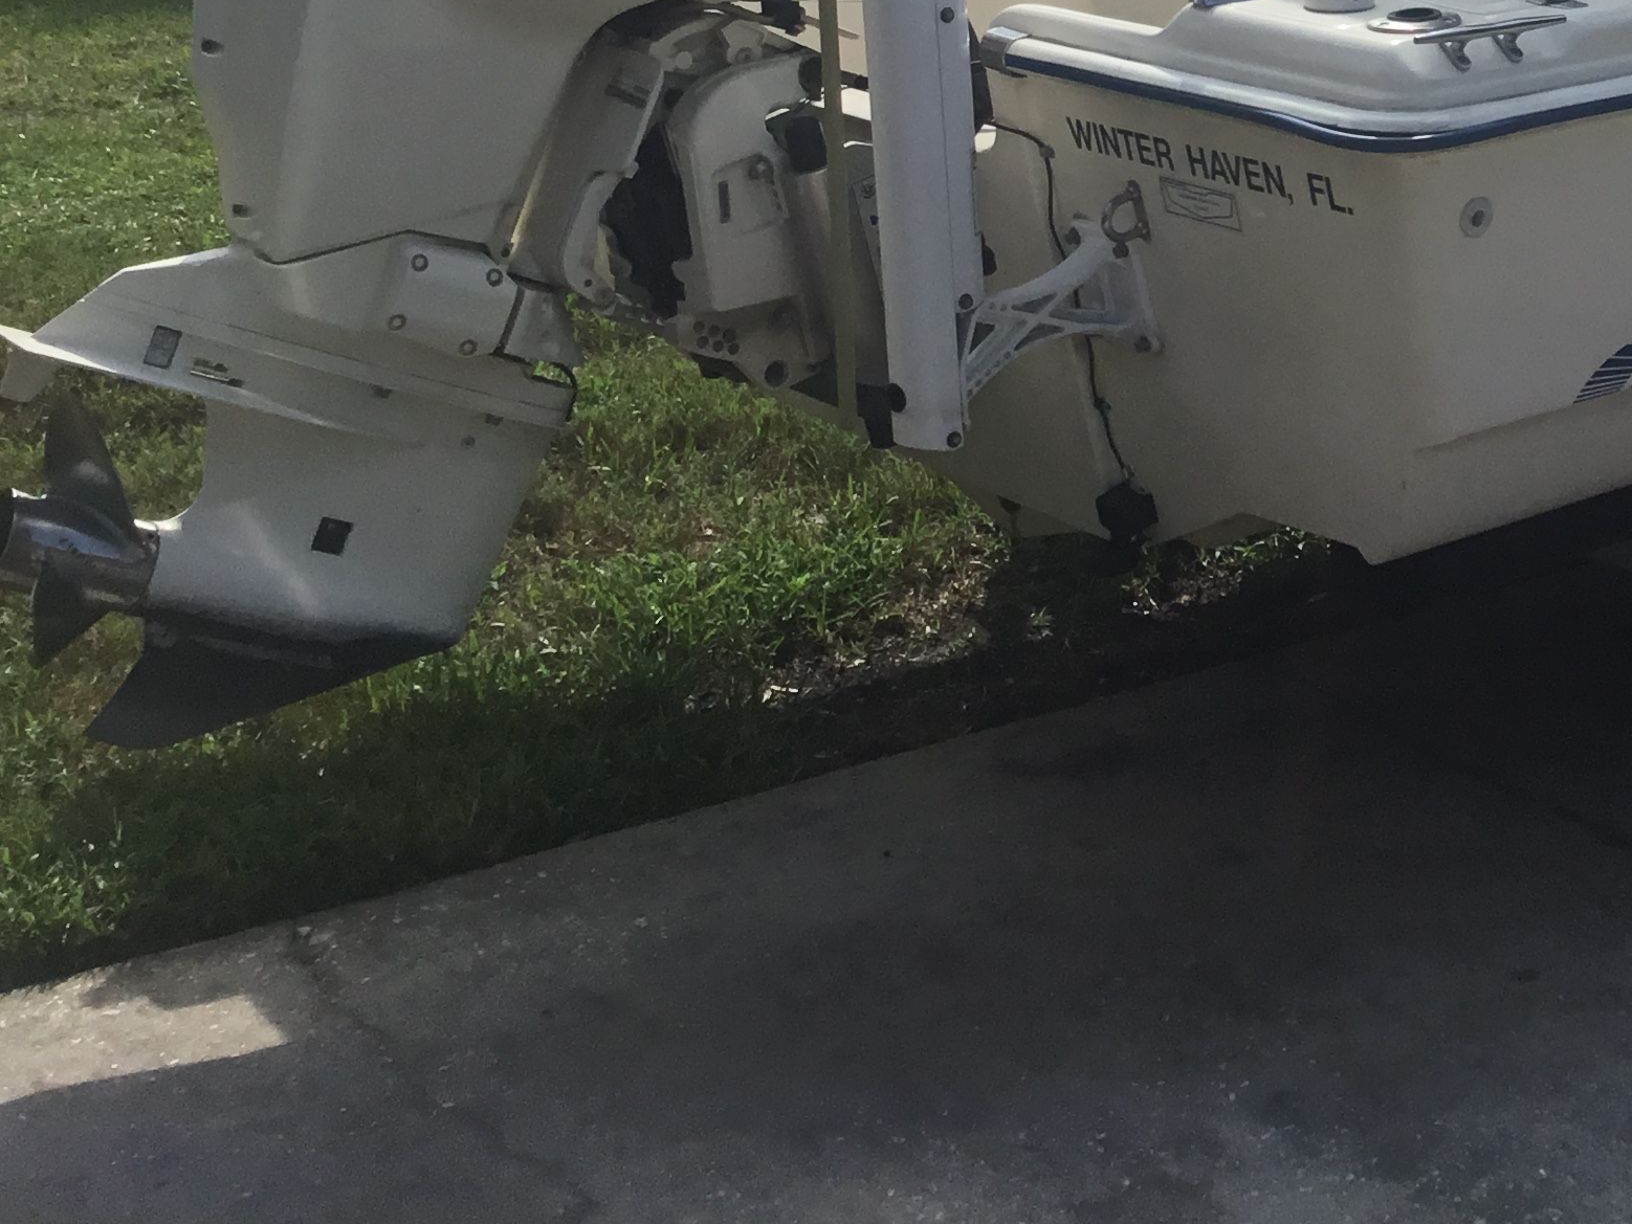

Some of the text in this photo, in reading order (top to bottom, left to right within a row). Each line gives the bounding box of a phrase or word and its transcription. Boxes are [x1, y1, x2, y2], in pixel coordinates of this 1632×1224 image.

[1066, 116, 1354, 215] WINTER HAVEN, FL.
